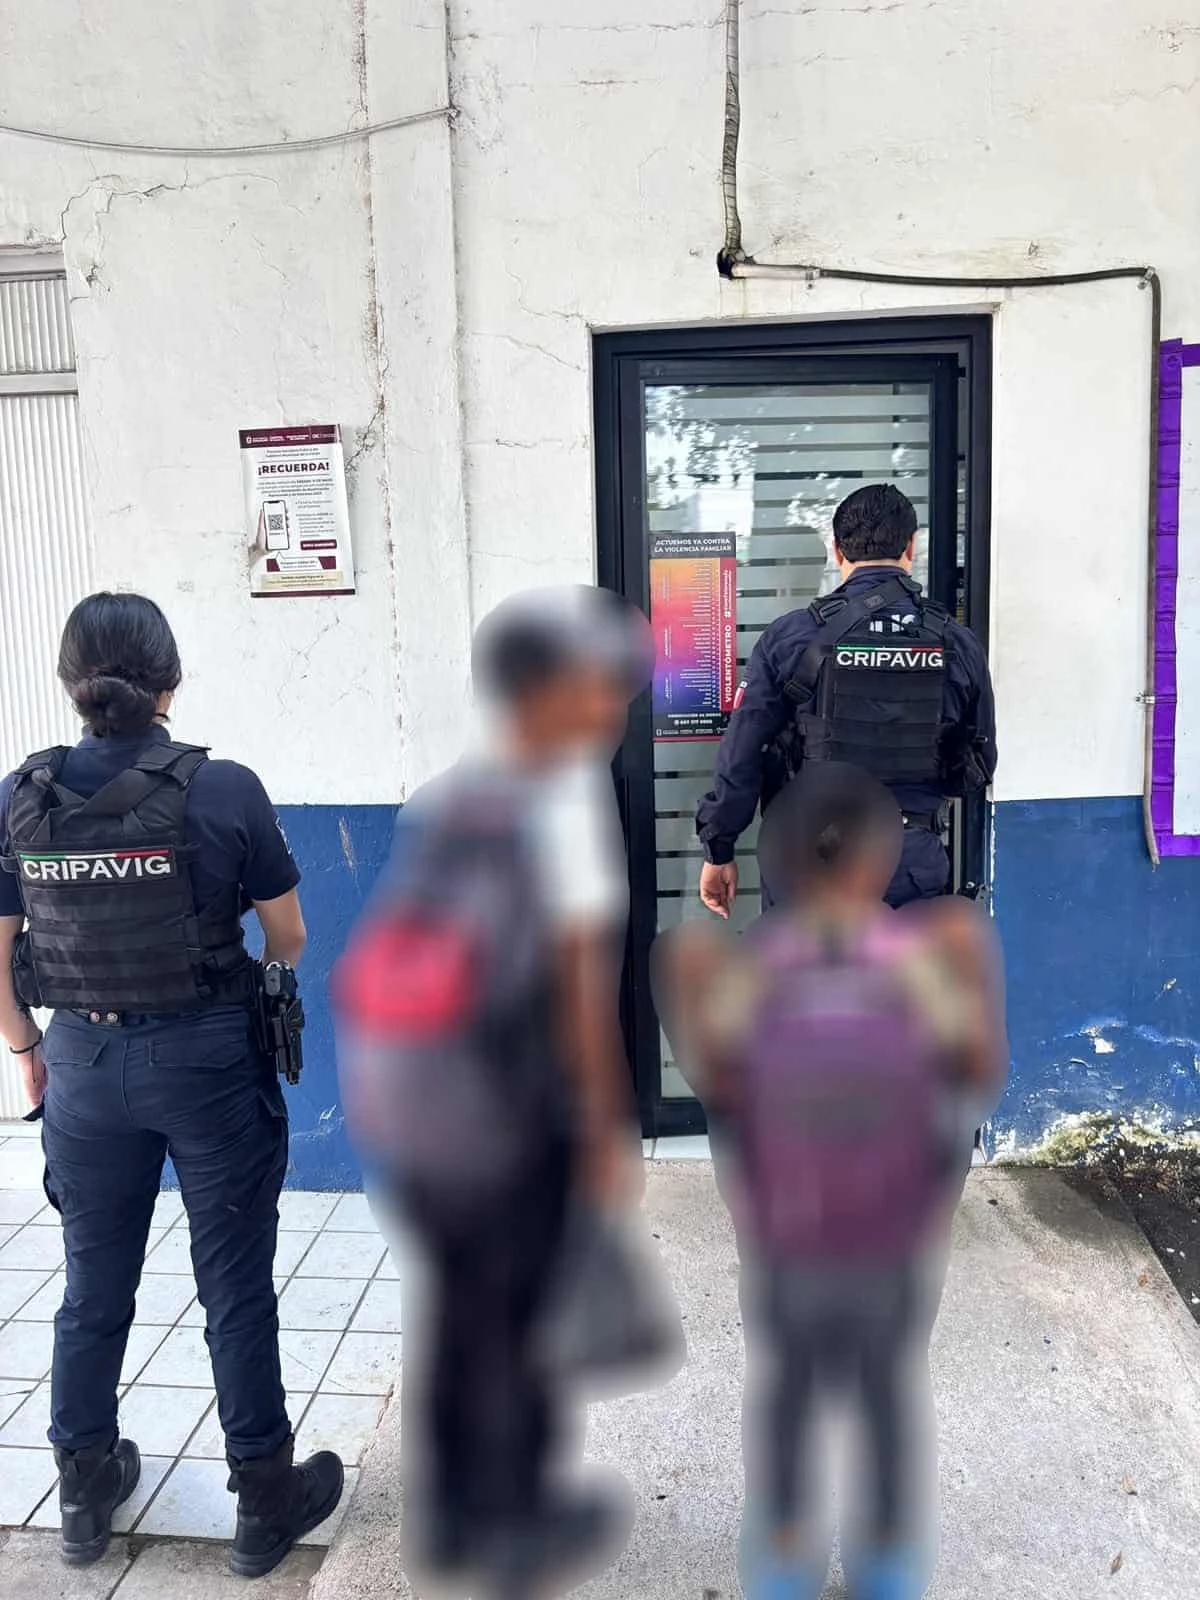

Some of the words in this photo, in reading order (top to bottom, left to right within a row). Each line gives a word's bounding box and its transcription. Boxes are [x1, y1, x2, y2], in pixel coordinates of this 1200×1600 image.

[258, 462, 330, 476] ¡RECUERDA!
[655, 538, 692, 546] ACTUEMOS
[664, 545, 700, 553] VIOLENCIA
[724, 624, 732, 704] VIOLENTÓMETRO
[836, 651, 943, 667] CRIPAVIG
[23, 855, 171, 881] CRIPAVIG
